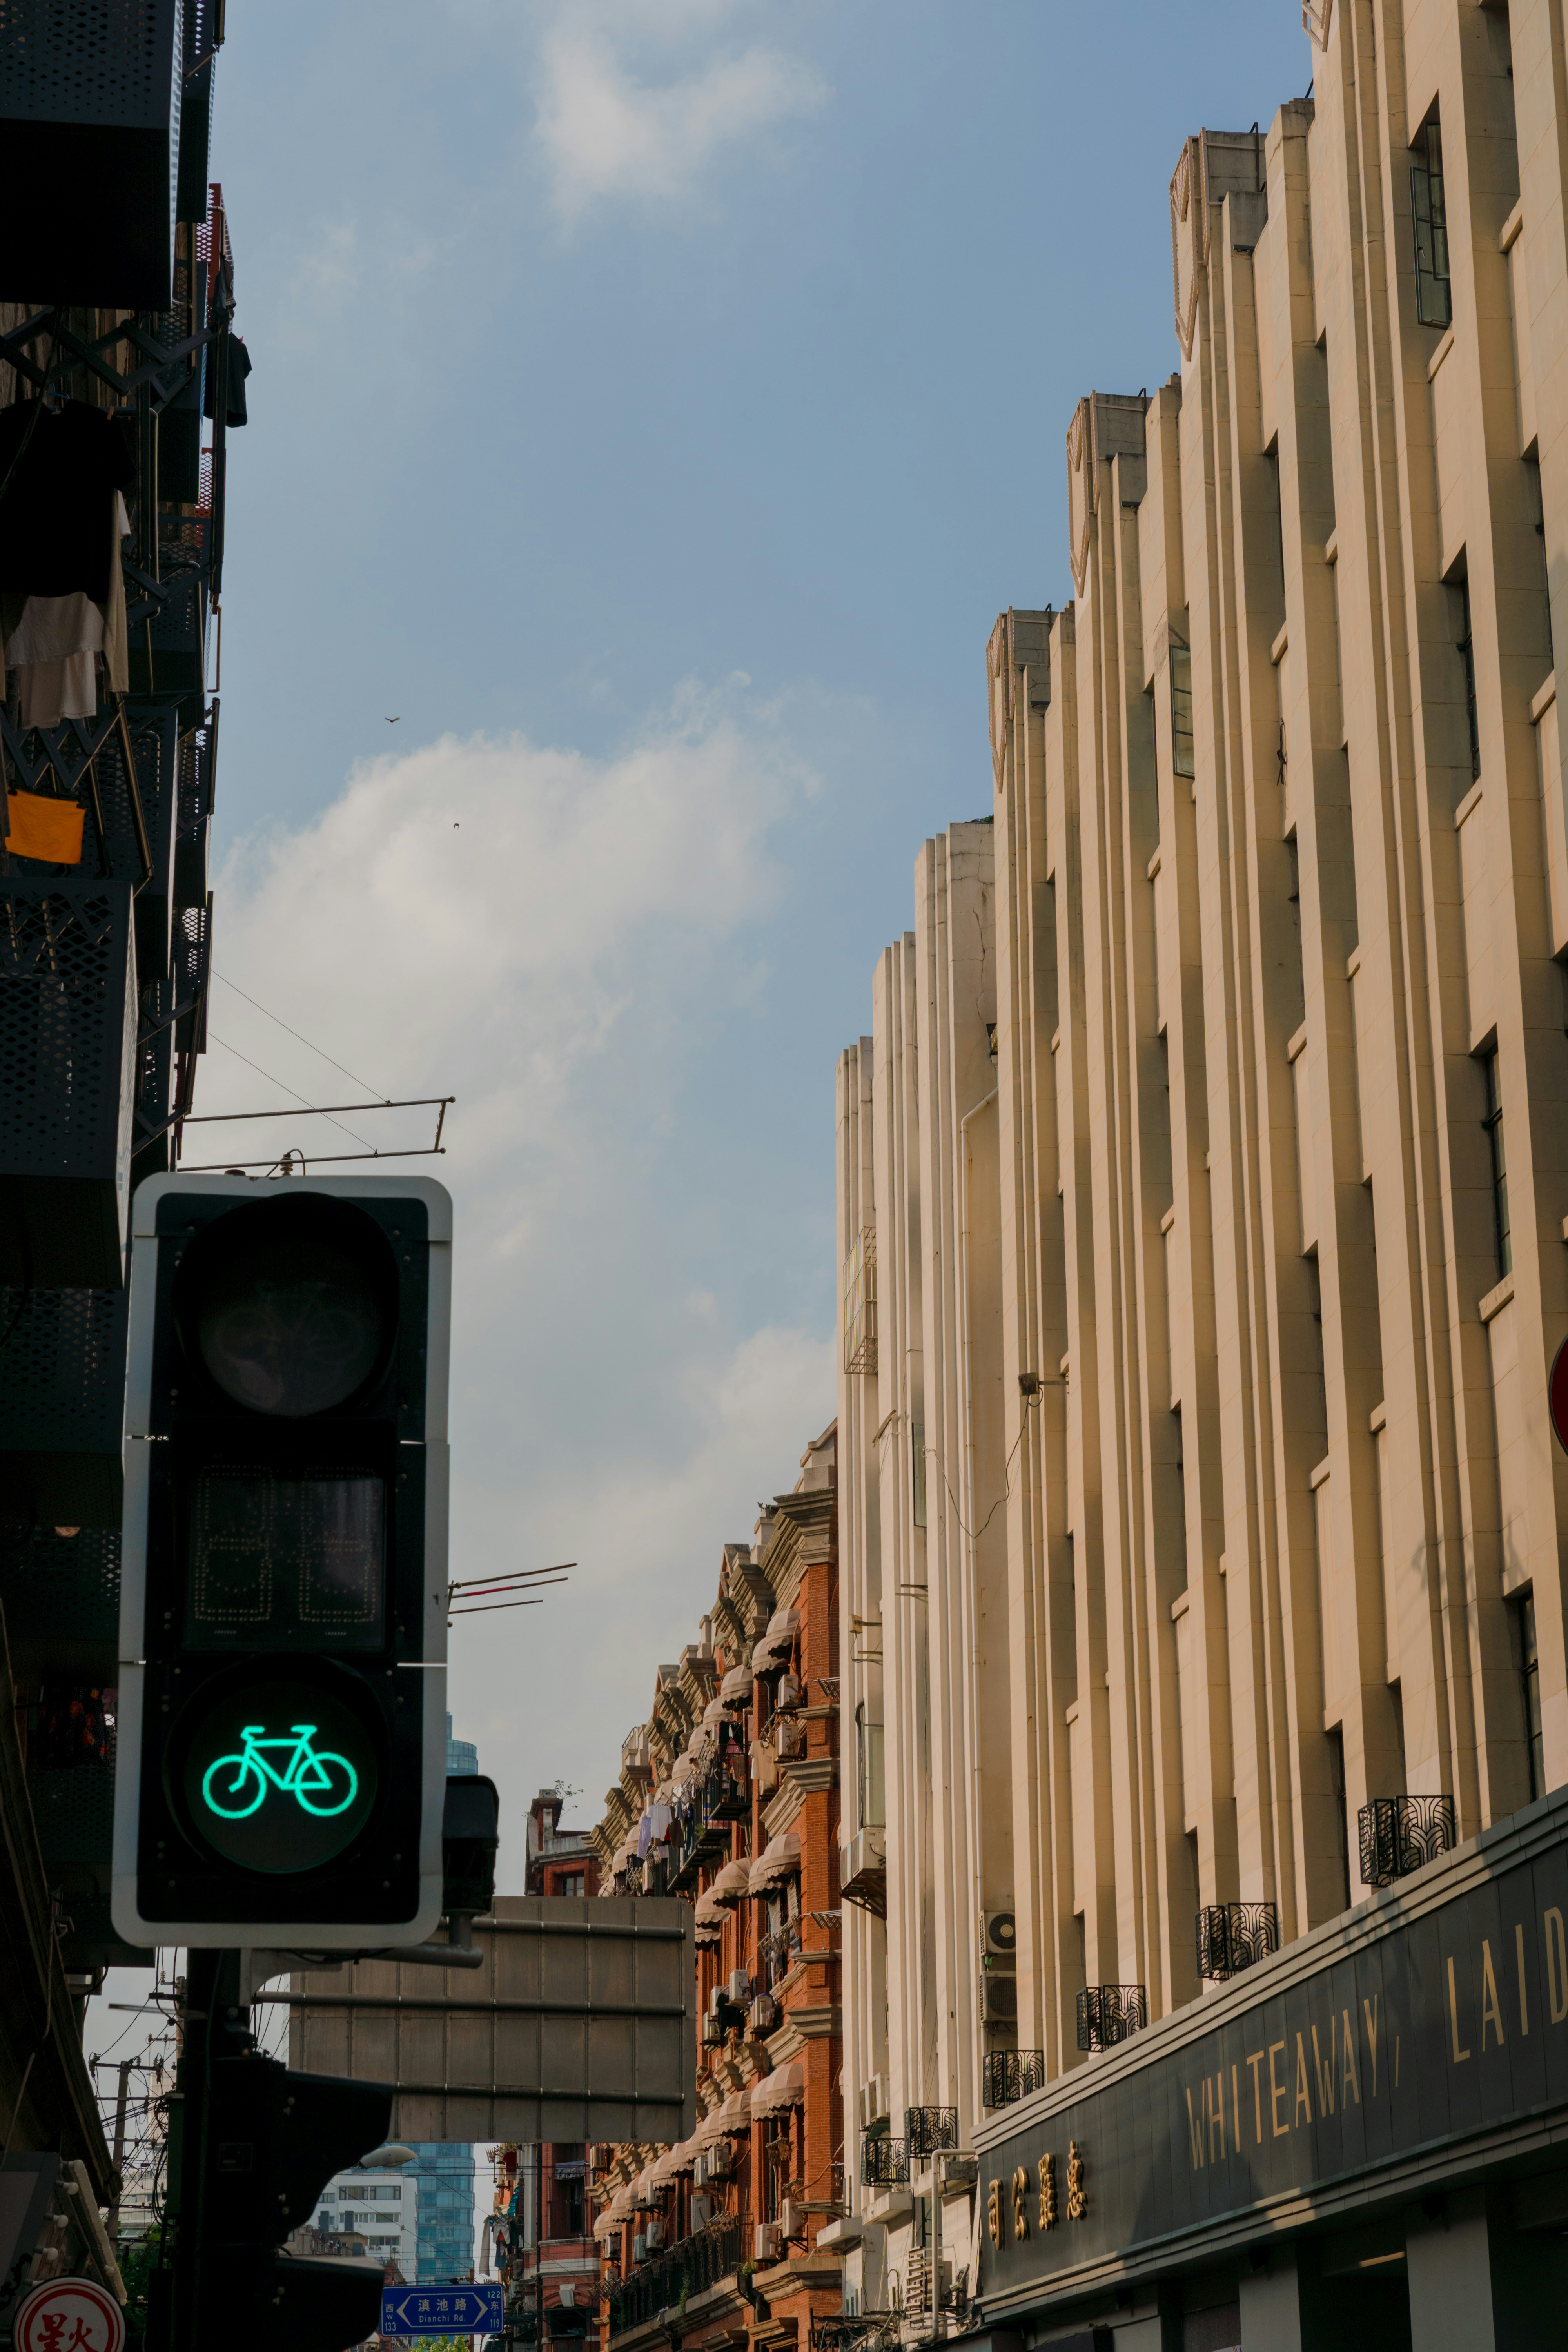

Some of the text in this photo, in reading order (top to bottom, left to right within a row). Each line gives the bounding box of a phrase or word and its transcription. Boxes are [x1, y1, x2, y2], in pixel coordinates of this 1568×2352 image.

[1186, 1907, 1568, 2171] WHITEAWAY, LAID
[385, 2304, 394, 2313] 西
[418, 2298, 467, 2312] 滇池路
[490, 2301, 499, 2310] 东
[419, 2314, 449, 2323] Dianchi
[385, 2322, 396, 2332] 133
[490, 2319, 499, 2328] 119
